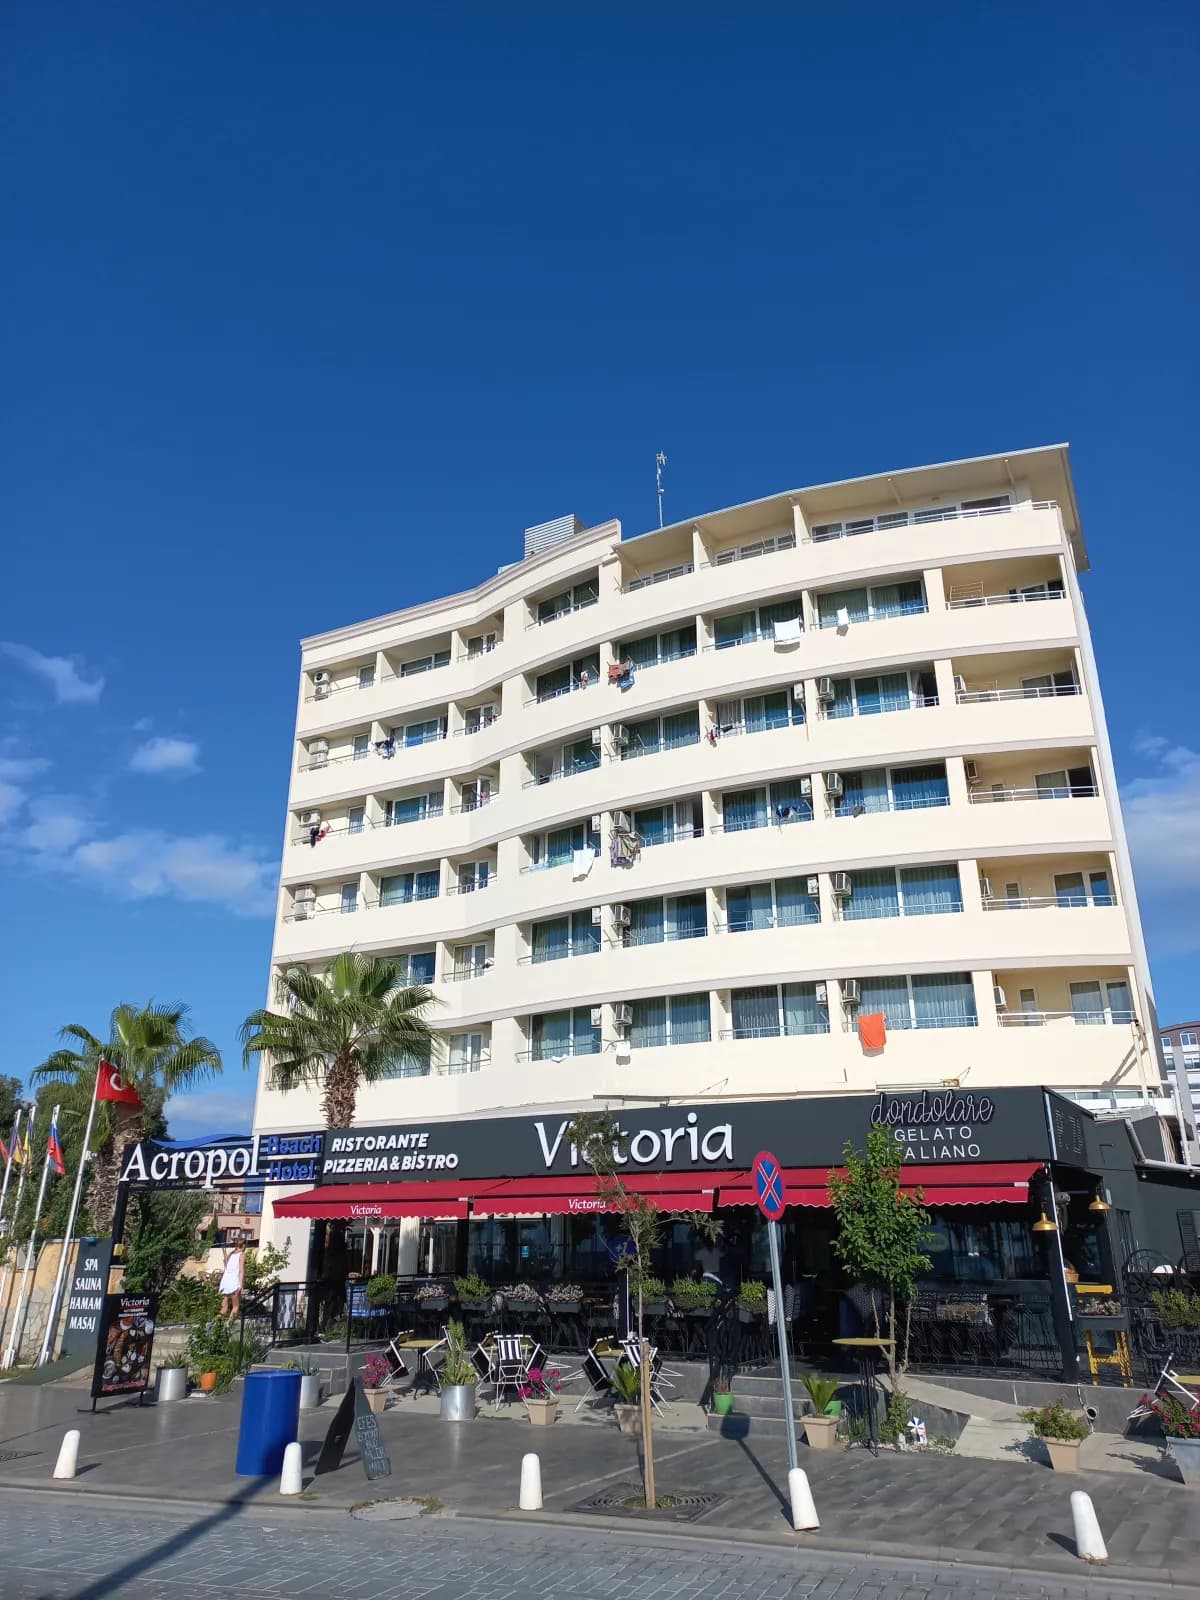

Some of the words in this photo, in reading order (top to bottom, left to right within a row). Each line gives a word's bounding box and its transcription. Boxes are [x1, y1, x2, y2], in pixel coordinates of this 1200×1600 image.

[871, 1089, 994, 1124] dondolare
[331, 1132, 429, 1153] RISTORANTE
[534, 1112, 733, 1168] Victoria
[894, 1126, 972, 1142] GELATO
[267, 1133, 320, 1155] Beach
[886, 1144, 981, 1160] ALIANO
[119, 1134, 261, 1189] Acropol
[269, 1159, 315, 1180] Hotel
[350, 1204, 382, 1216] Victoria
[83, 1258, 99, 1272] SPA
[74, 1277, 102, 1291] SAUNA
[69, 1296, 102, 1311] HAMAM
[120, 1296, 150, 1308] Victoria
[69, 1316, 96, 1334] MASAJ
